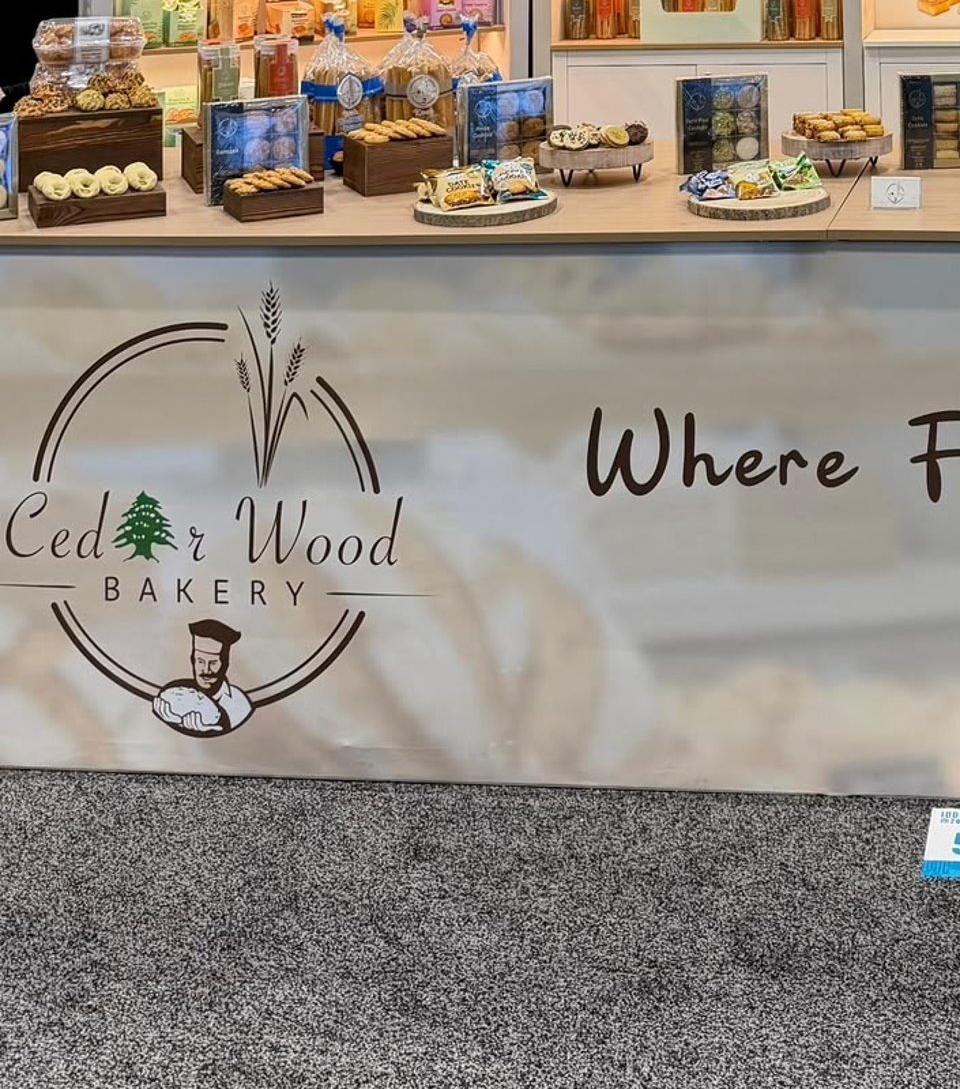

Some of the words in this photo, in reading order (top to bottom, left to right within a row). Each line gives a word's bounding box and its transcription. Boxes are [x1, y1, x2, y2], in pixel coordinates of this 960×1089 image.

[586, 406, 859, 498] Where
[5, 490, 206, 563] Cedr
[235, 495, 404, 567] Wood
[104, 575, 305, 607] BAKERY
